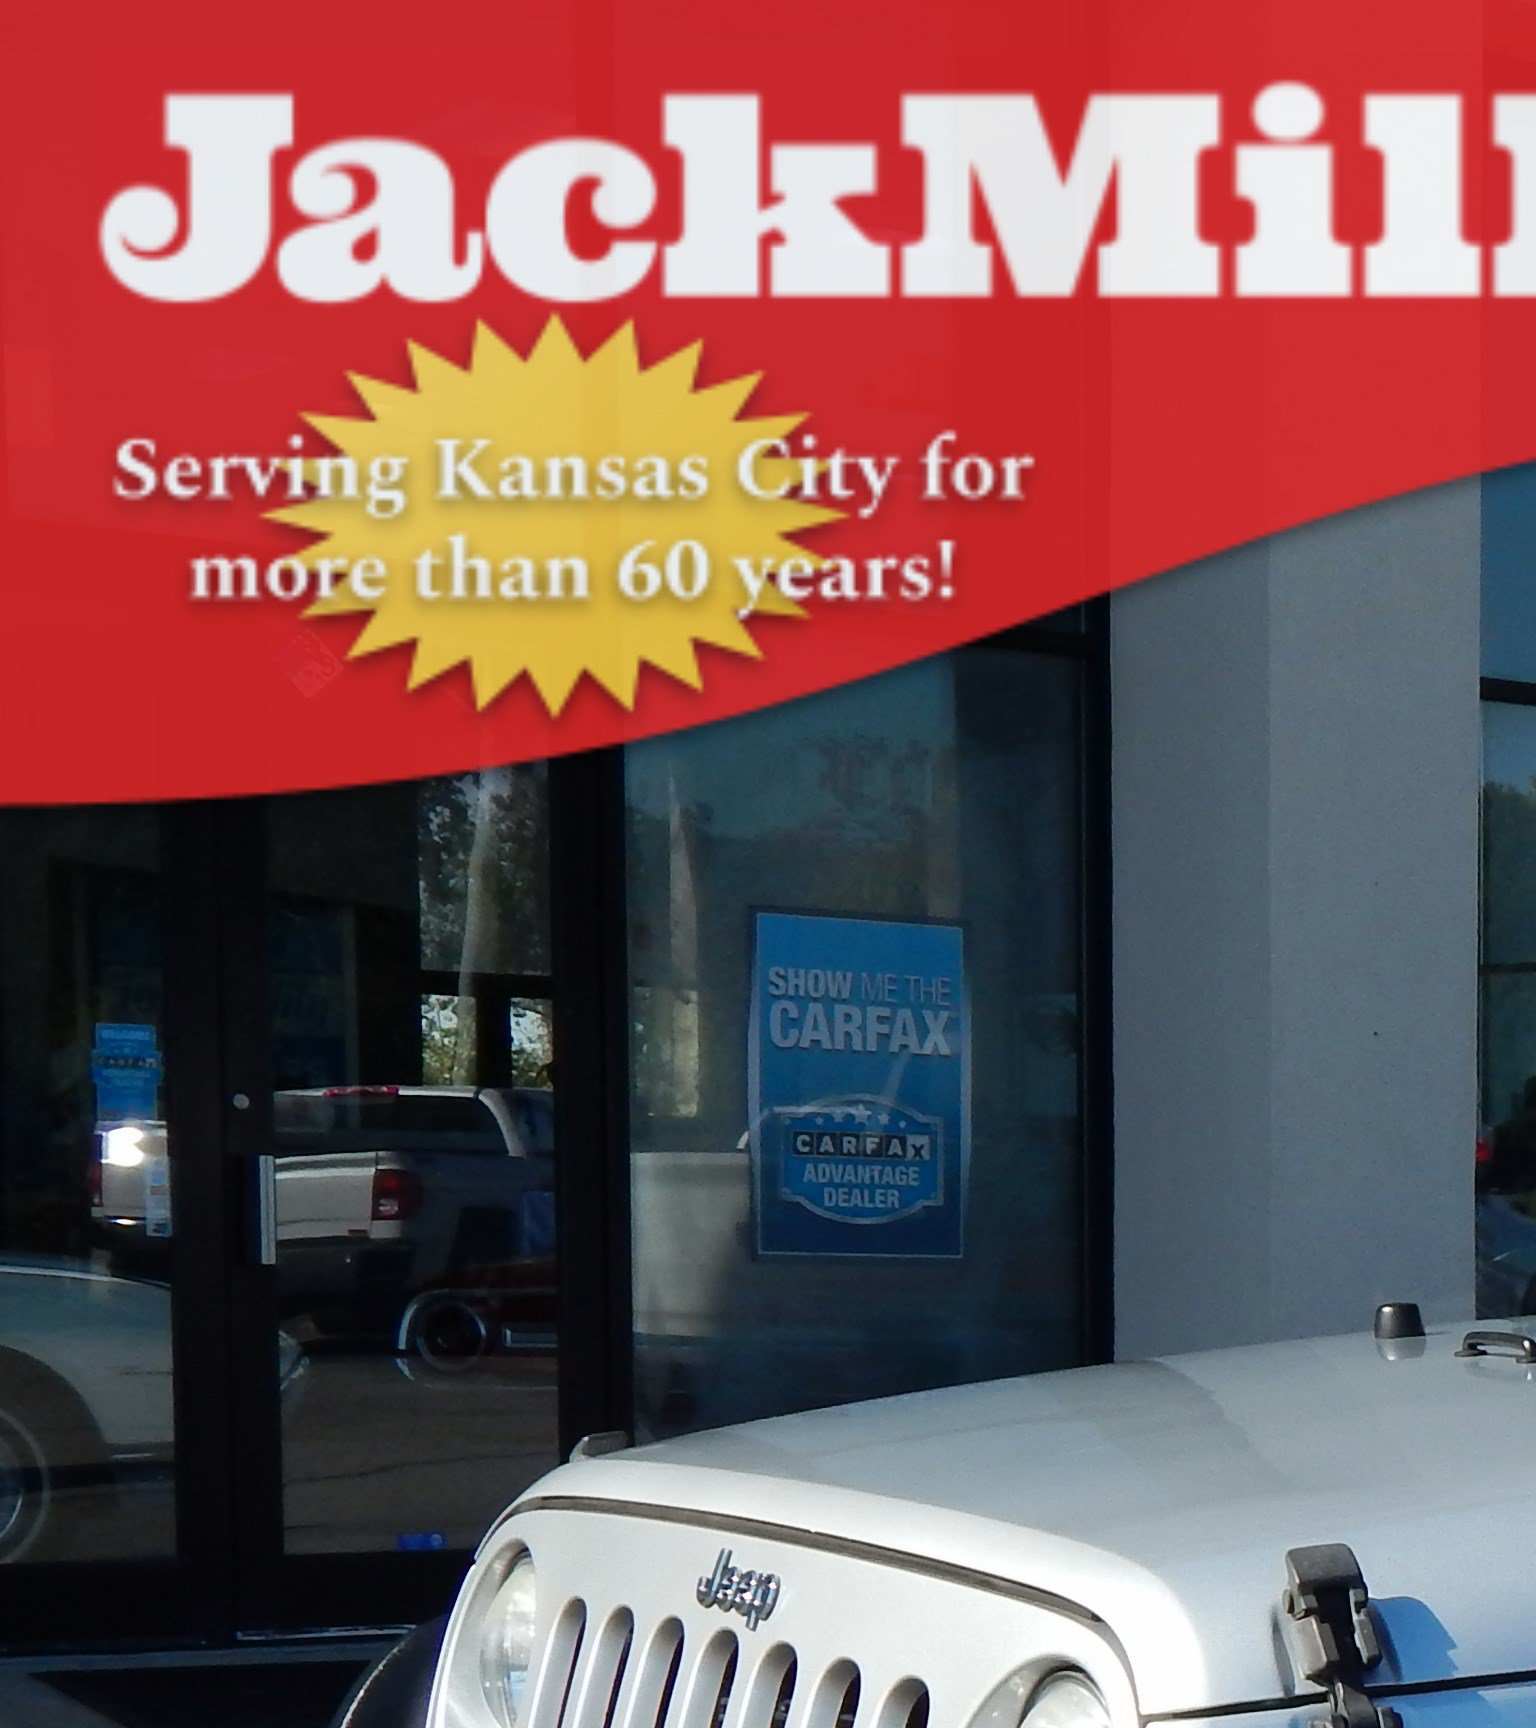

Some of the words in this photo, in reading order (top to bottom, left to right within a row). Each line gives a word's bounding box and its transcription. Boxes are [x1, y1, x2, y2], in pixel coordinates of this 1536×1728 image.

[767, 965, 852, 1001] SHOW
[860, 972, 898, 1003] ME
[904, 974, 951, 1006] THE
[769, 1000, 951, 1056] CARFAX
[794, 1132, 930, 1162] CARFAX
[802, 1163, 921, 1187] ADVANTAGE
[823, 1187, 900, 1209] DEALER
[696, 1547, 781, 1632] Jeep
